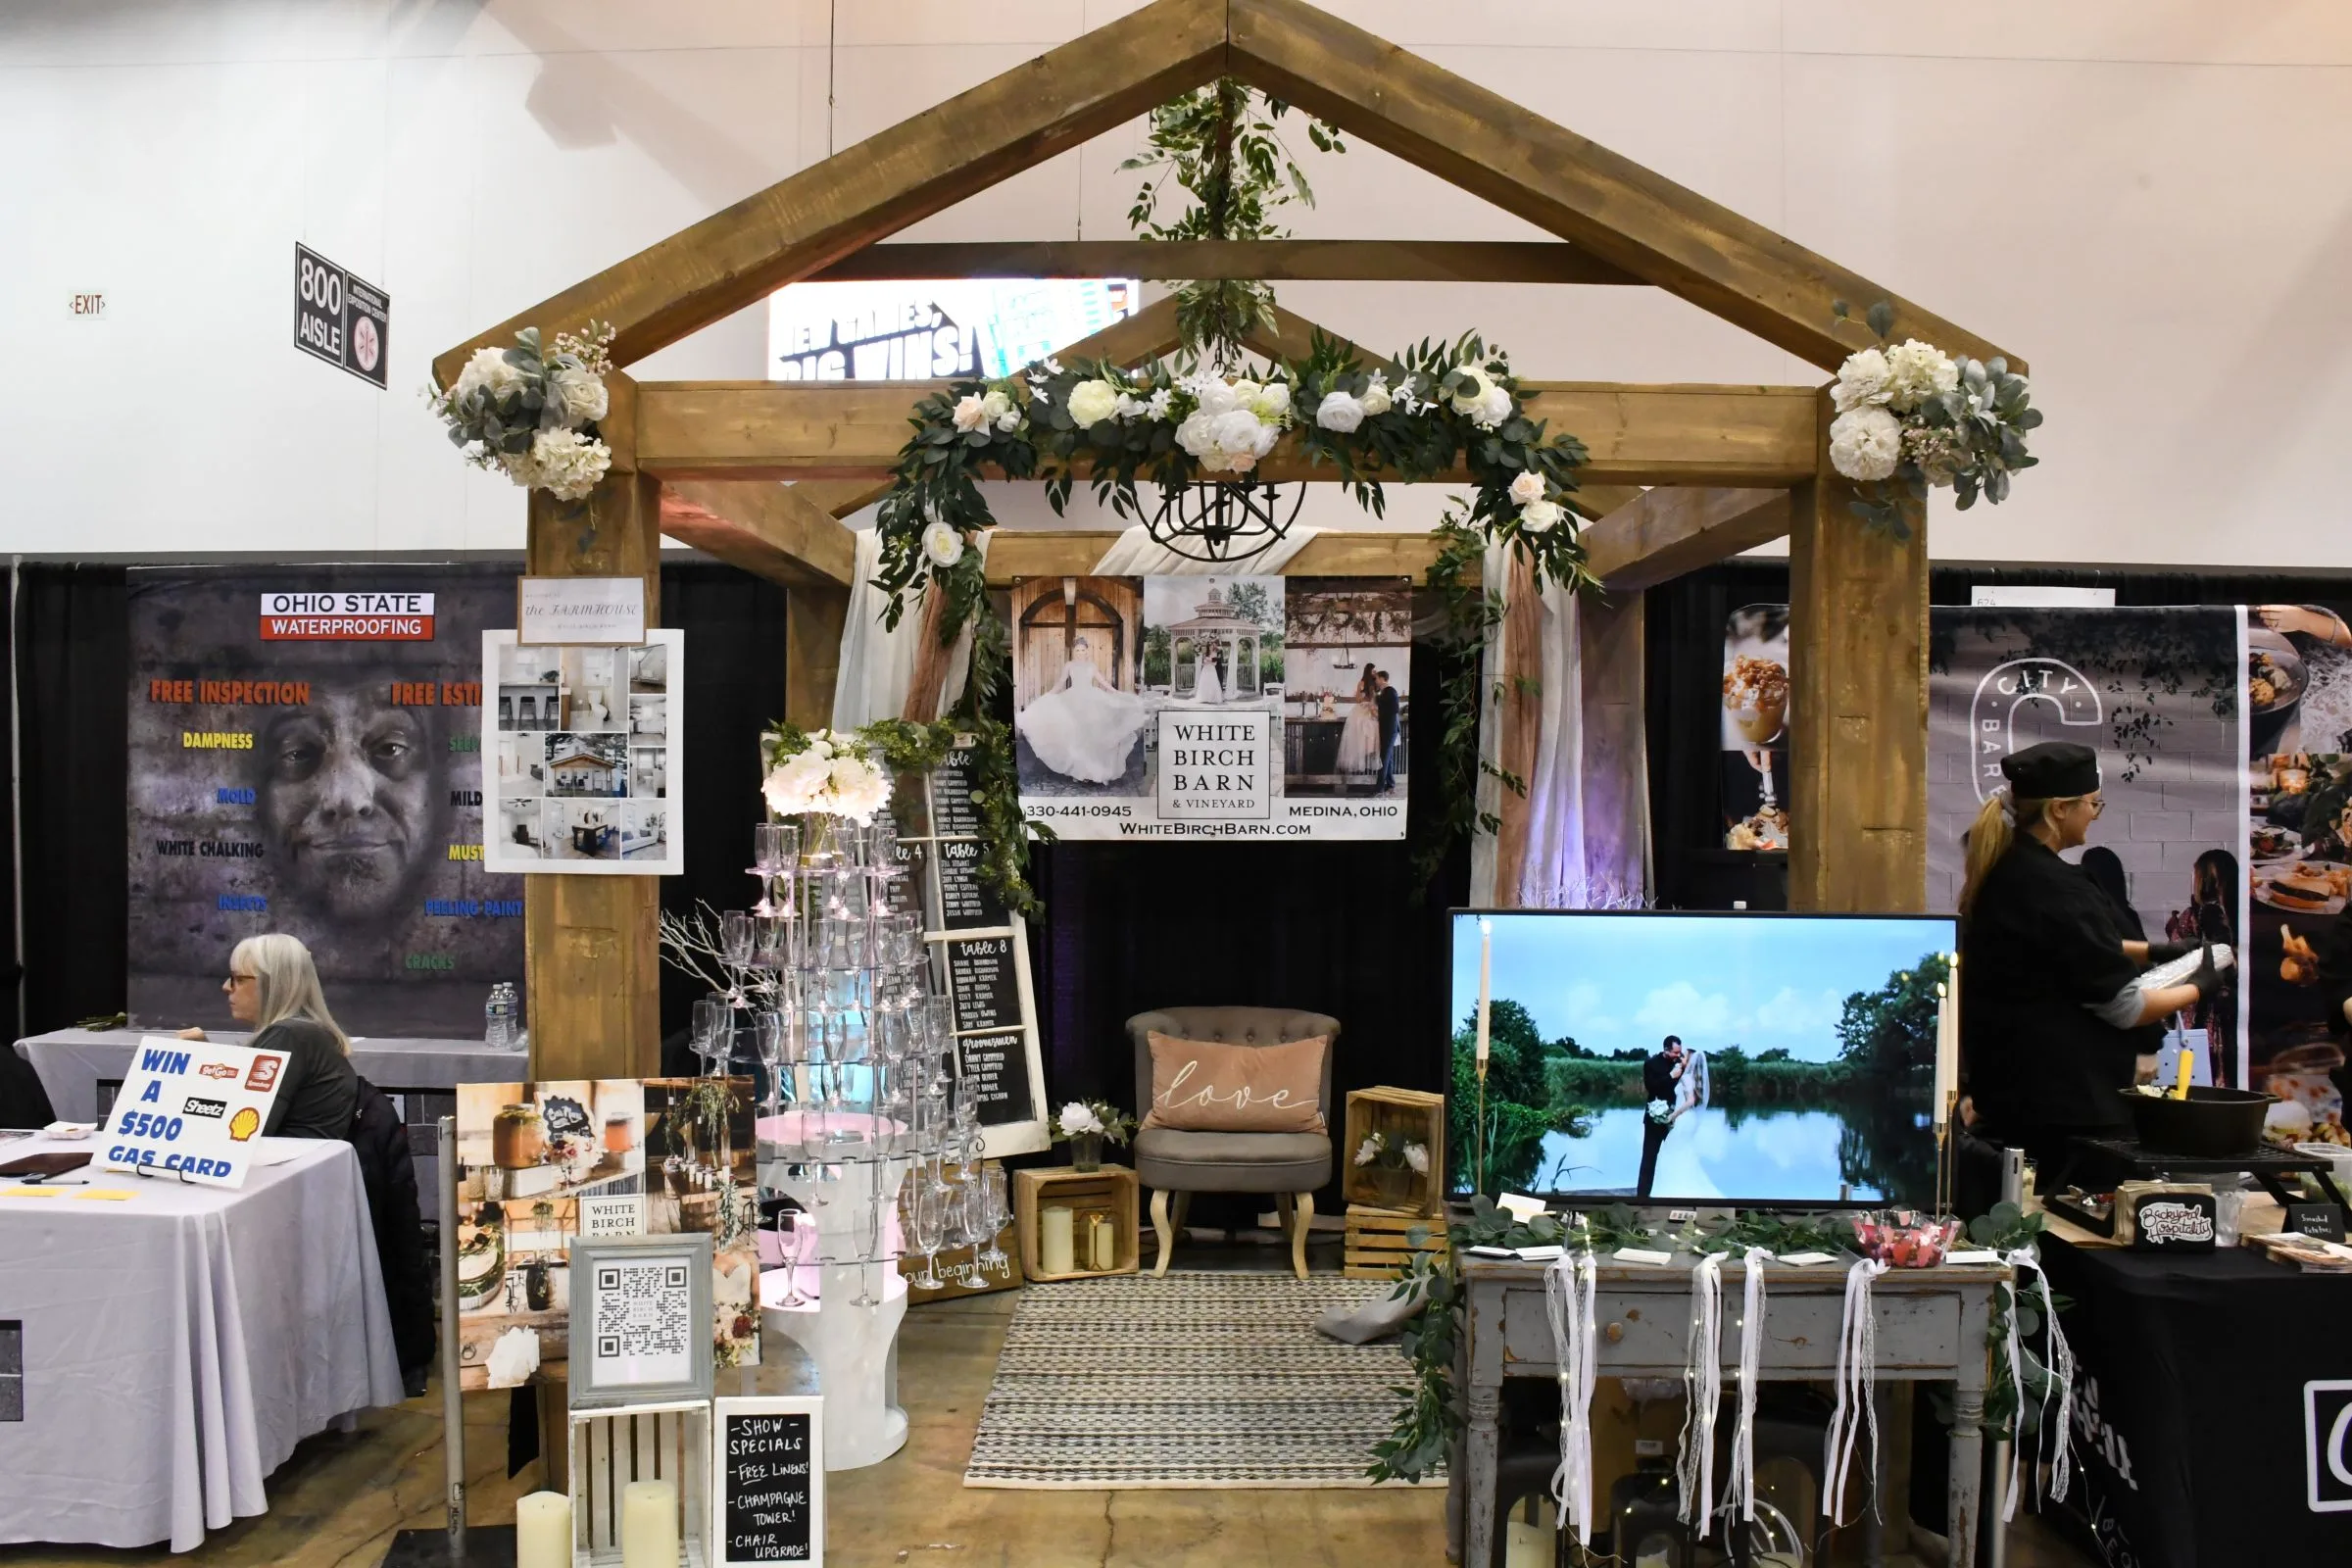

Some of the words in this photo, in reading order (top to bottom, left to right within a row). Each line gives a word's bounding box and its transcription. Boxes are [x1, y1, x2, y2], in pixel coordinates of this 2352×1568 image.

[300, 258, 341, 316] 800
[74, 295, 102, 315] EXIT
[300, 312, 340, 357] AISLE
[272, 595, 334, 613] OHIO
[345, 594, 422, 612] STATE
[271, 618, 422, 635] WATERPROOFING
[1997, 669, 2079, 696] CITY
[150, 680, 193, 705] FREE
[200, 680, 310, 705] INSPECTION
[392, 682, 434, 705] FREE
[440, 683, 482, 706] ESTI
[183, 732, 253, 750] DAMPNESS
[1173, 724, 1255, 741] WHITE
[448, 736, 481, 753] SEEP
[1173, 750, 1255, 766] BIRCH
[1173, 774, 1254, 791] BARN
[218, 788, 256, 805] MOLD
[1172, 799, 1182, 808] &
[1186, 799, 1255, 808] VINEYARD
[1026, 805, 1132, 817] 330-441-0945
[1289, 806, 1357, 818] MEDINA,
[1359, 806, 1398, 817] OHIO
[157, 840, 195, 857] WHITE
[200, 841, 264, 858] CHALKING
[914, 843, 923, 859] 4
[944, 842, 978, 858] table
[424, 901, 478, 917] PEELING
[484, 901, 523, 917] PAINT
[960, 941, 997, 956] table
[1000, 939, 1007, 954] 8
[406, 954, 455, 970] CRACKS
[141, 1049, 191, 1075] WIN
[140, 1080, 162, 1103] A
[1153, 1060, 1319, 1109] love
[184, 1100, 224, 1116] Sheetz
[118, 1108, 183, 1141] $500
[108, 1146, 156, 1165] GAS
[165, 1153, 232, 1178] CARD
[592, 1204, 635, 1215] WHITE
[592, 1217, 635, 1229] BIRCH
[741, 1418, 783, 1437] SHOW
[729, 1438, 803, 1455] SPECIALS
[738, 1462, 768, 1481] FREE
[738, 1491, 807, 1509] CHAMPAGNE
[753, 1510, 796, 1526] TOWER!
[736, 1533, 777, 1548] CHAIR
[755, 1543, 808, 1559] UPGRADE!
